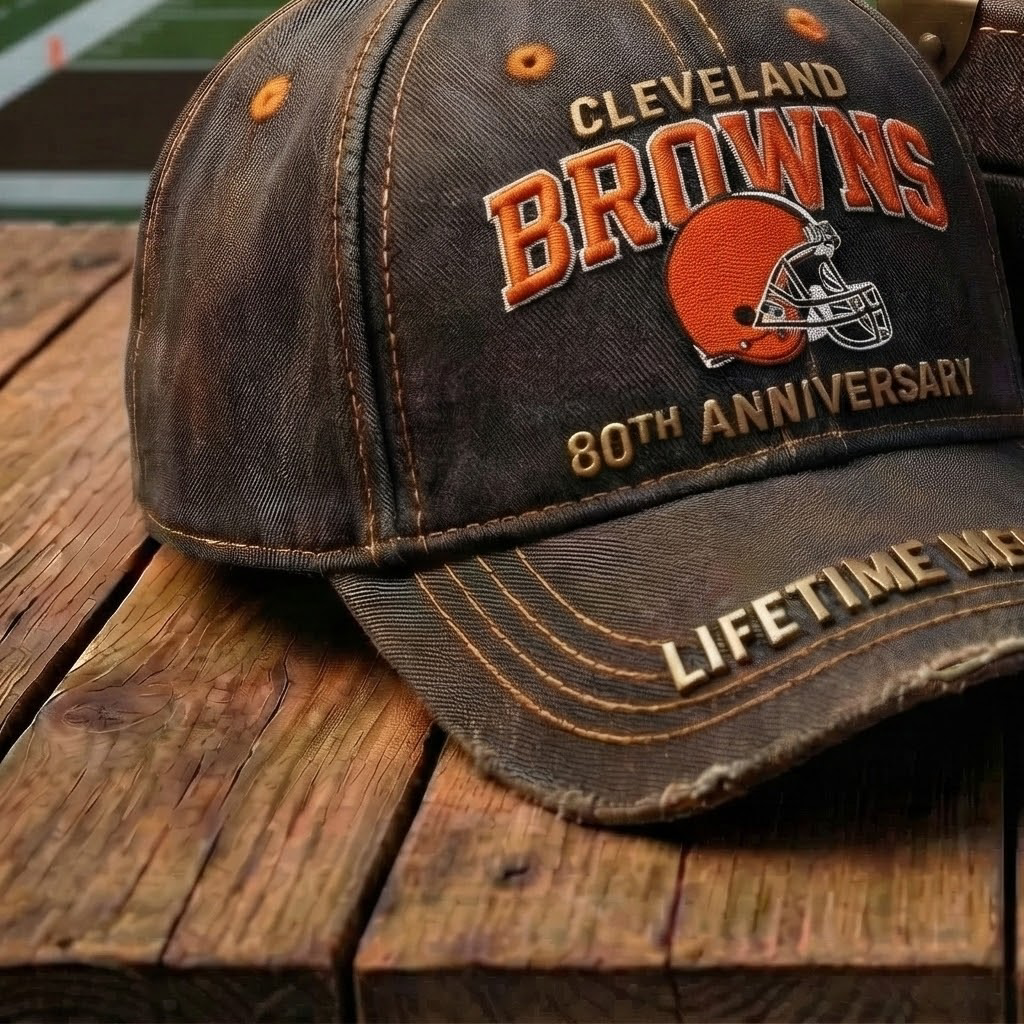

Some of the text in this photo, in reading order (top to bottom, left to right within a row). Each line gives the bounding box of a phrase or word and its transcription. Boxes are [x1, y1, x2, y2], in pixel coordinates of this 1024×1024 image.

[570, 60, 848, 139] CLEVELAND
[483, 105, 949, 313] BROWNS
[567, 357, 976, 478] 80TH ANNIVERSARY
[660, 539, 948, 696] LIFETIME
